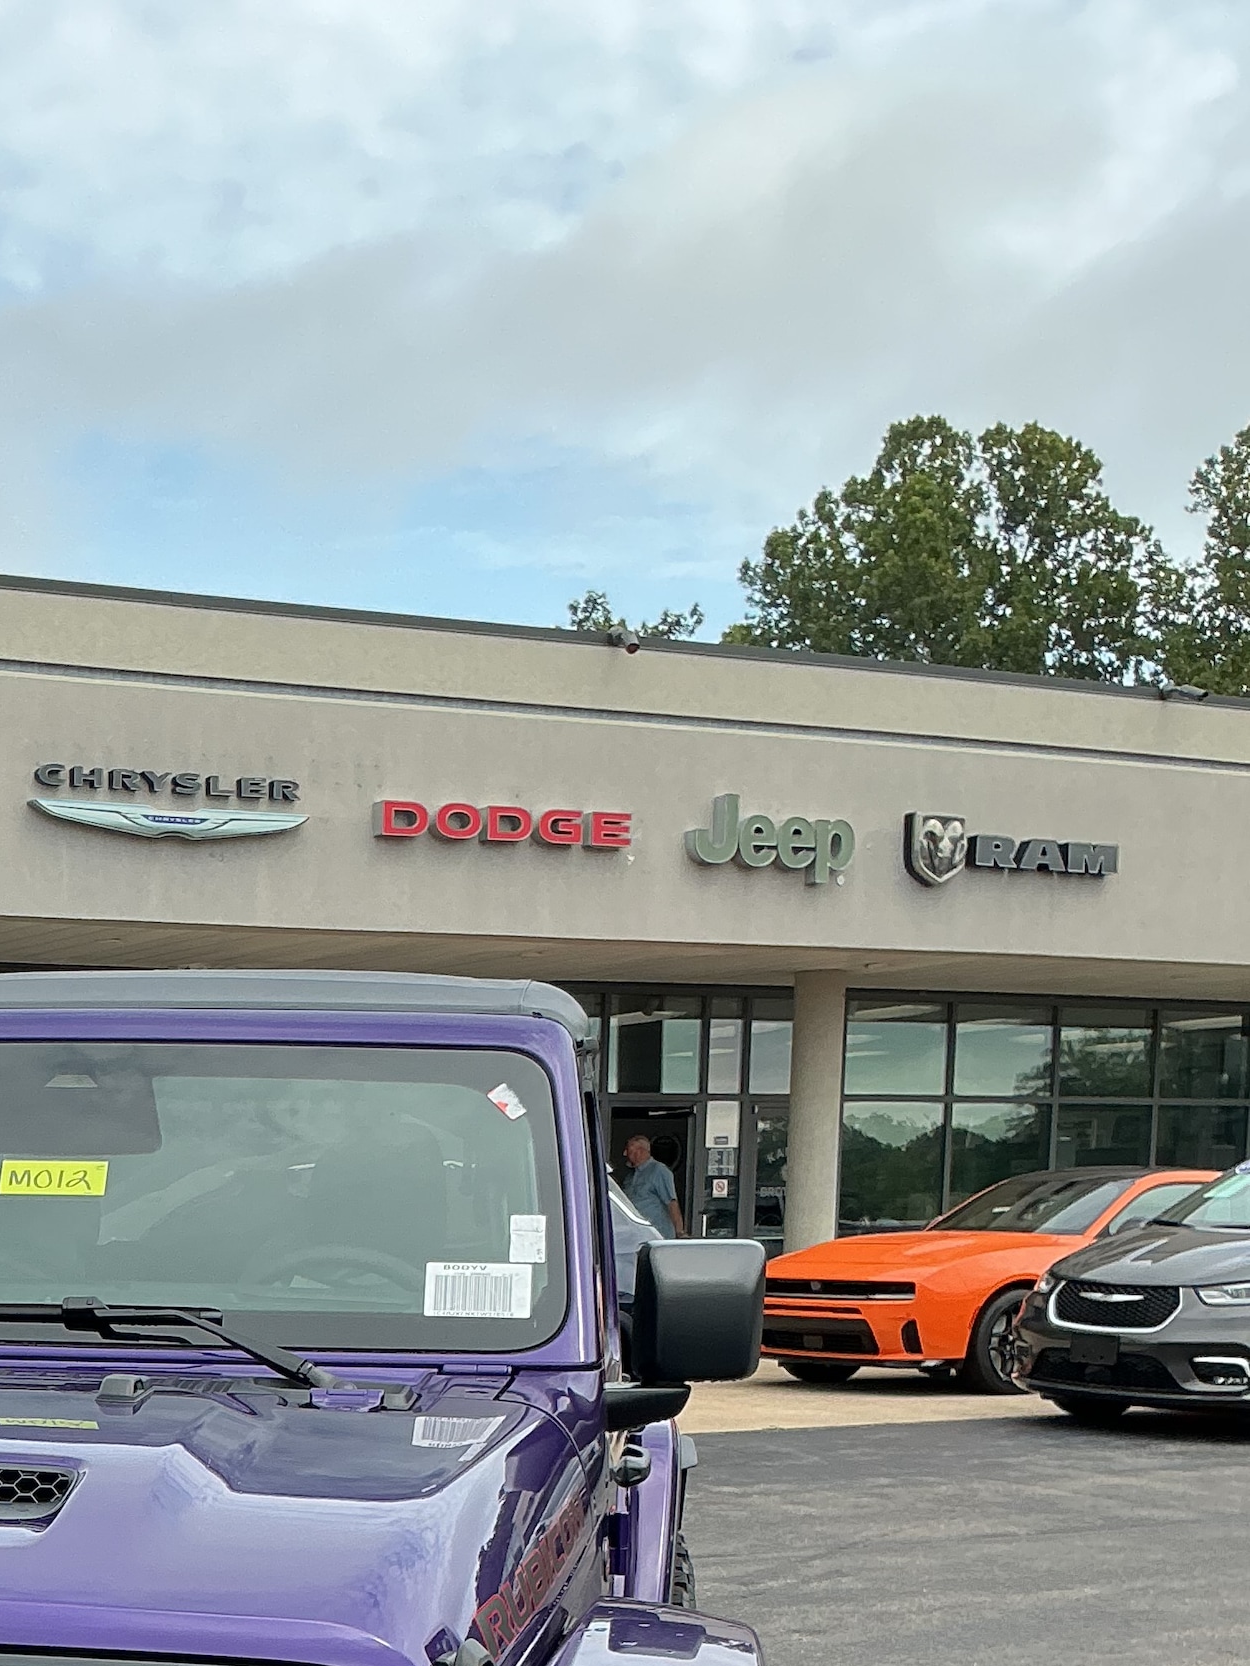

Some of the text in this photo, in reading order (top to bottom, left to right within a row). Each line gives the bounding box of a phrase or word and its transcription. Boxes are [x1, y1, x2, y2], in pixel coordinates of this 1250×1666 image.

[34, 763, 301, 801] CHRYSLER
[374, 799, 632, 848] DODGE
[685, 793, 856, 886] Jeep
[967, 833, 1119, 875] RAM
[474, 1488, 586, 1662] RUBICON
